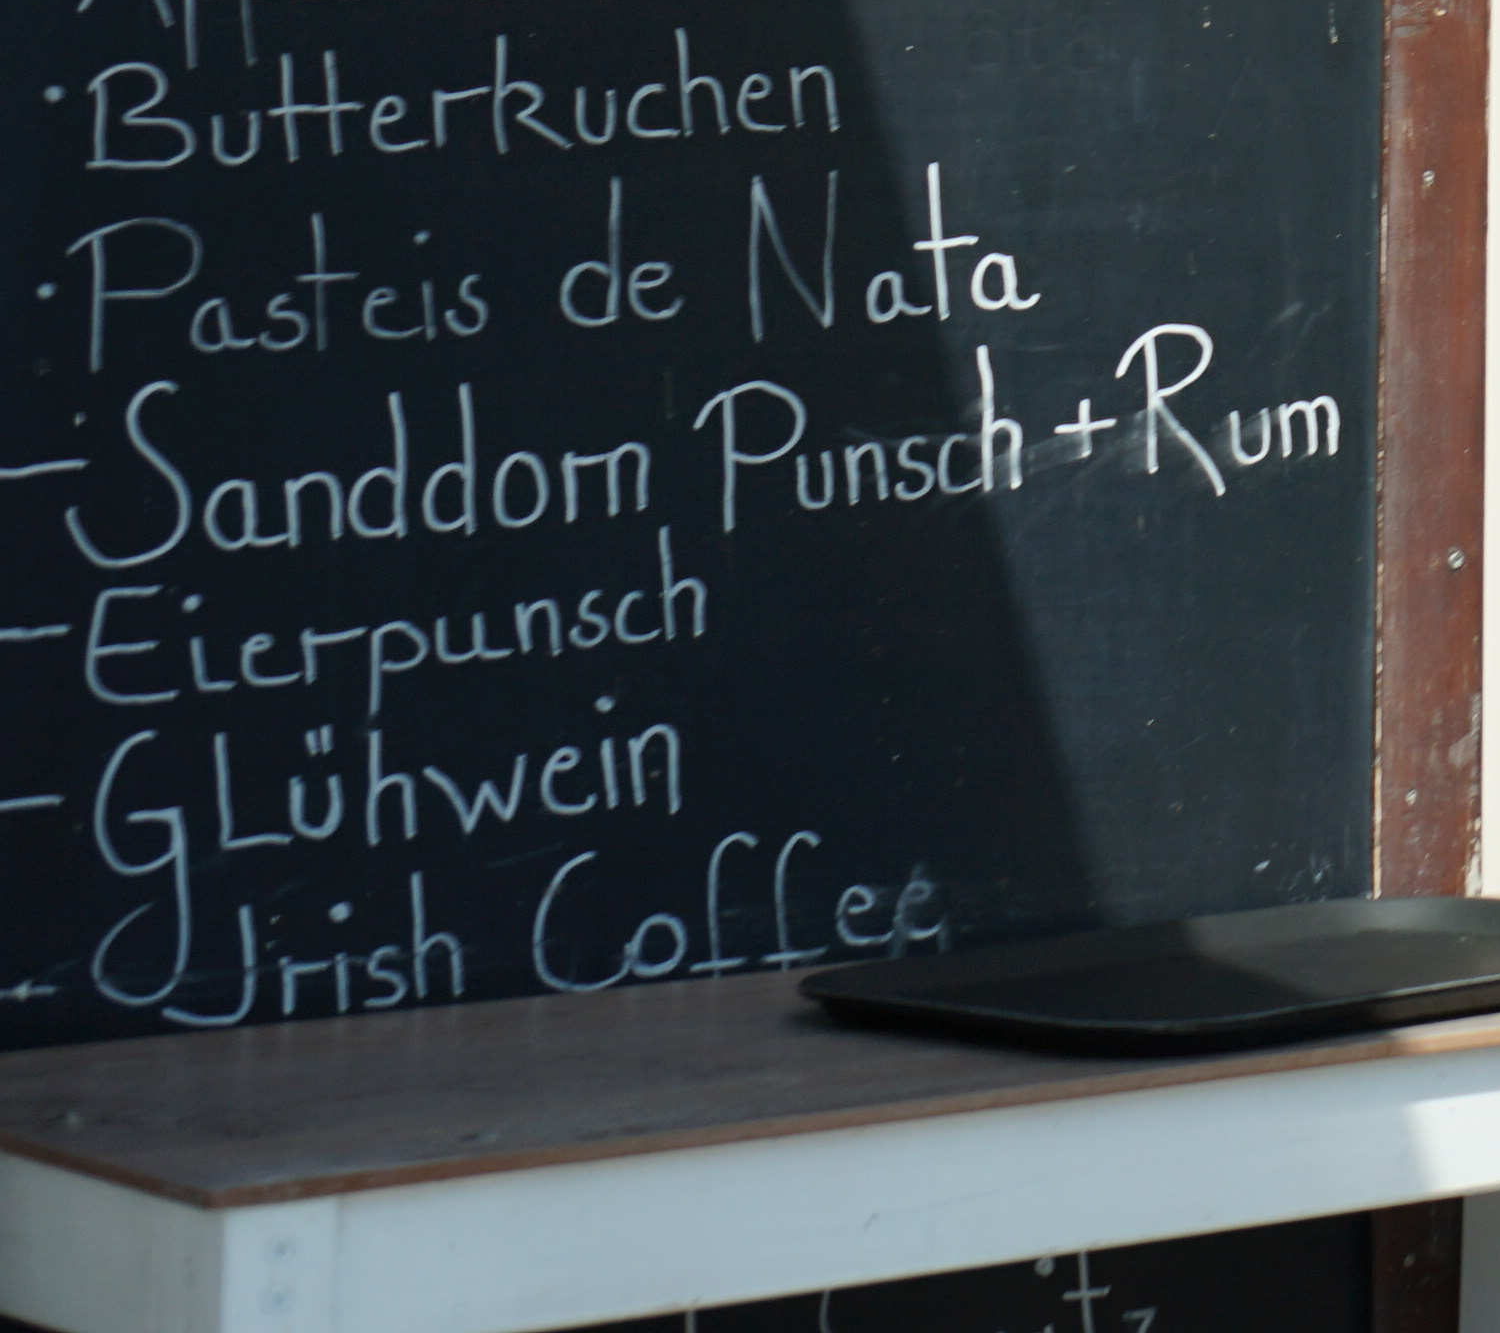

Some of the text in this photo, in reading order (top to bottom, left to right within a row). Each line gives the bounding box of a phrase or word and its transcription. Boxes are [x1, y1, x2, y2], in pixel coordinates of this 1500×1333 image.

[87, 28, 840, 170] Butterkuchen
[68, 163, 1041, 373] Pasteis de Nata
[695, 344, 1022, 534] Punsch
[1116, 323, 1340, 498] Rum
[84, 528, 706, 717] Eierpunsch
[93, 697, 682, 1006] Glühwein
[535, 832, 945, 990] Coffee
